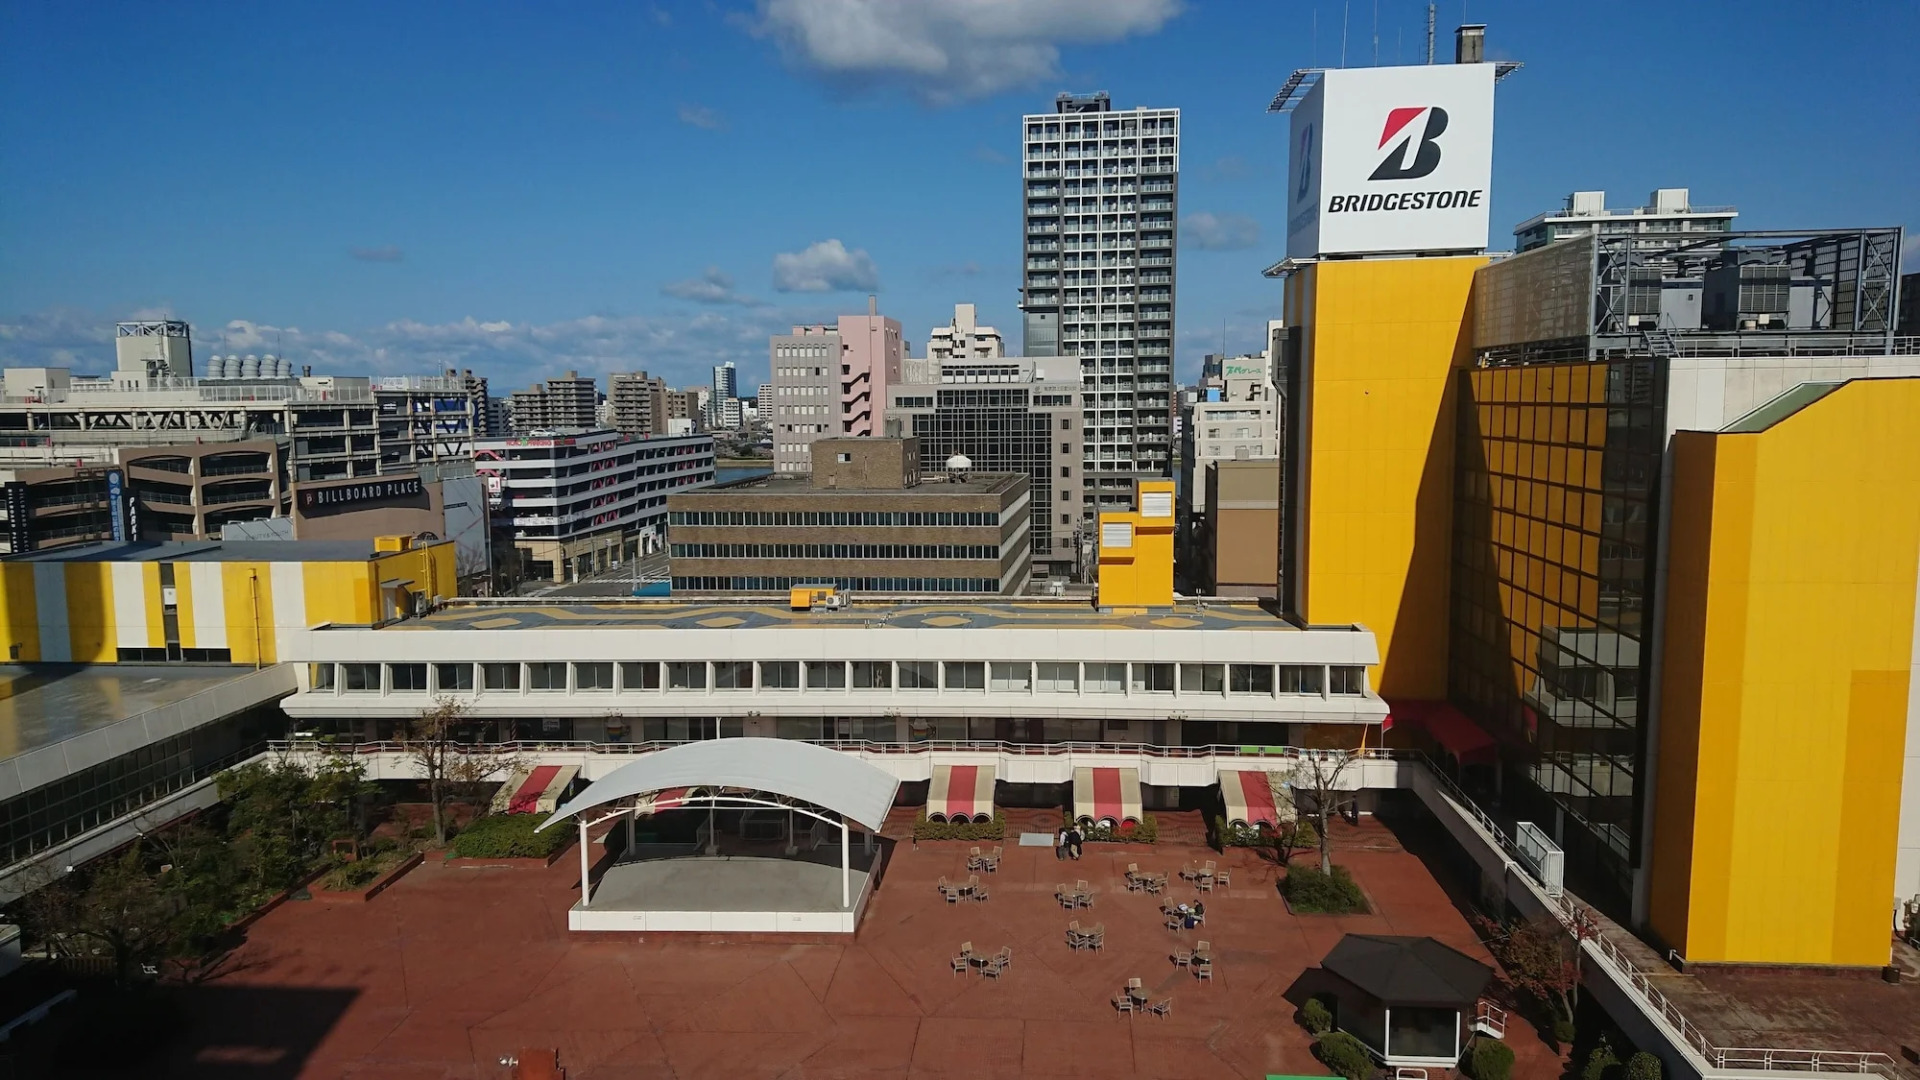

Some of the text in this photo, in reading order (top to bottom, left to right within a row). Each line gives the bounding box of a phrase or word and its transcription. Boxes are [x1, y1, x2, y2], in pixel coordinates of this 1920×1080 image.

[1328, 189, 1483, 213] BRIDGESTONE
[317, 481, 419, 504] BILLBOARD PLACE
